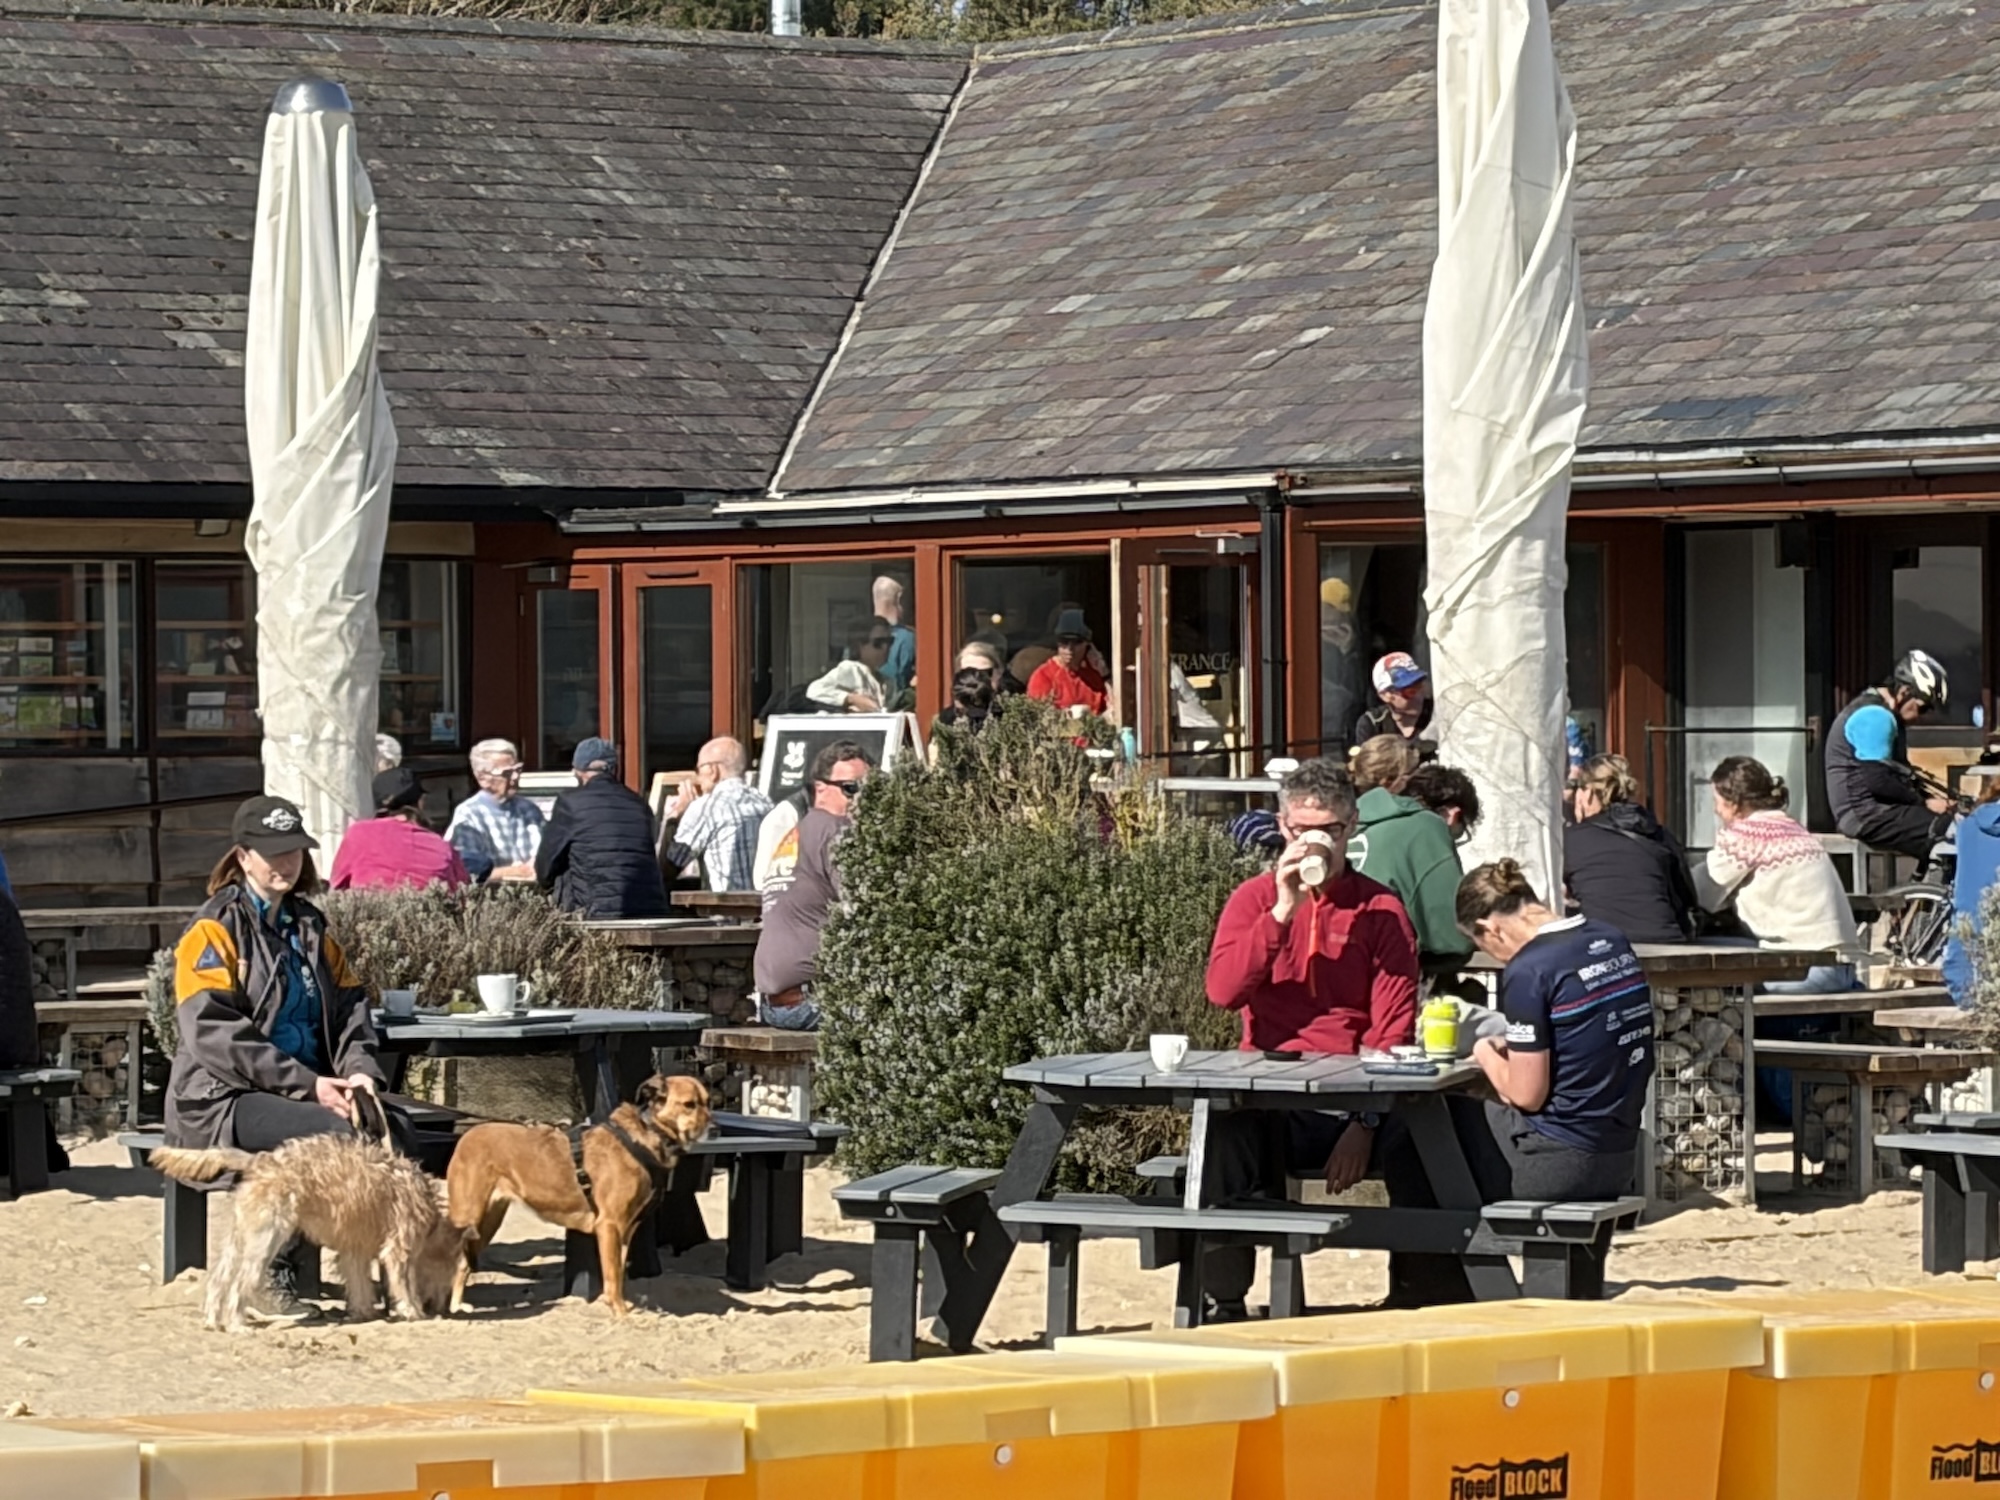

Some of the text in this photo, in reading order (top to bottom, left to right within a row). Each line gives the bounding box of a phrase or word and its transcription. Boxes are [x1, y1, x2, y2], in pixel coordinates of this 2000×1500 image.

[1929, 1453, 1974, 1481] Flood
[1450, 1467, 1563, 1500] Flood BLOCK
